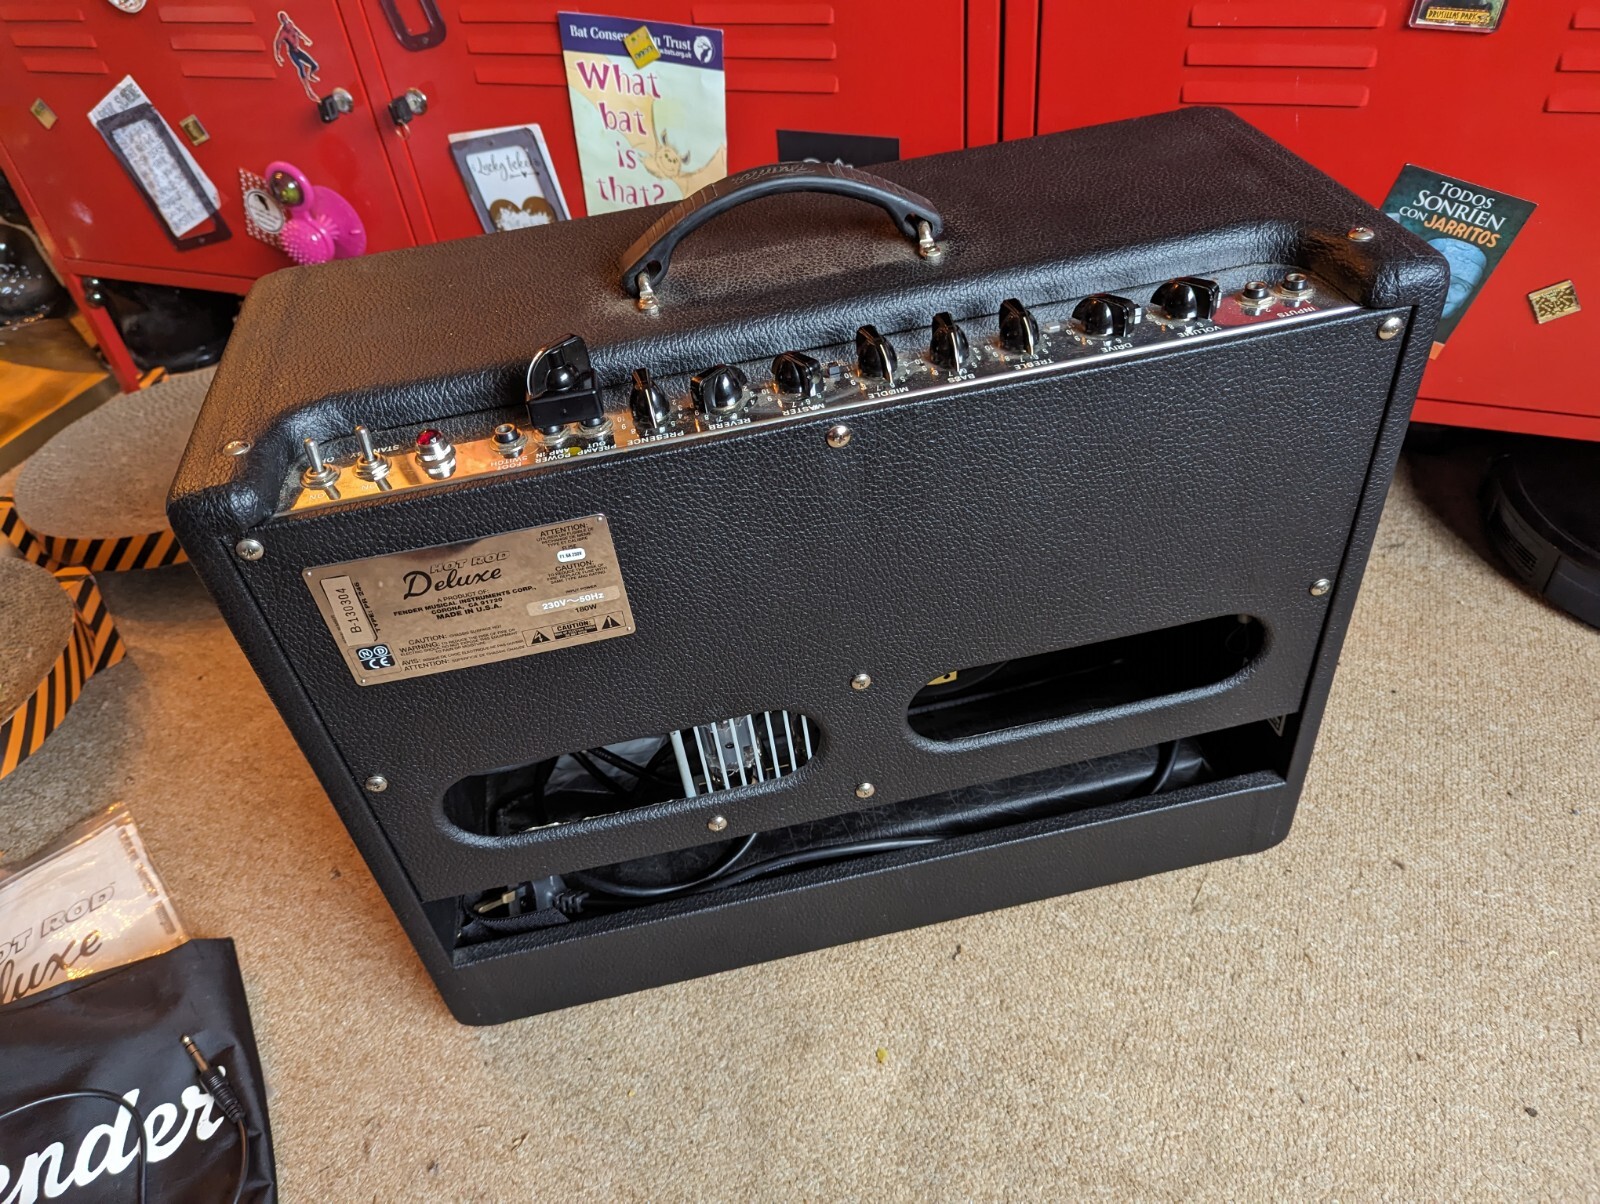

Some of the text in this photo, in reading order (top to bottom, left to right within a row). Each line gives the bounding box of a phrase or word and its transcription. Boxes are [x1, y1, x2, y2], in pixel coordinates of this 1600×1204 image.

[1460, 12, 1478, 20] PARK
[569, 24, 691, 51] Bat Consern Trust
[576, 61, 661, 99] What
[598, 102, 647, 135] bat
[616, 141, 637, 170] is
[596, 176, 665, 206] that?
[1440, 181, 1495, 210] TODOS
[1412, 189, 1507, 231] SONRÍEN
[1399, 206, 1502, 248] CON JARRITOS
[1276, 306, 1316, 318] INPUTS
[1177, 325, 1222, 338] VOLUME
[1100, 342, 1133, 353] DRIVE
[1014, 358, 1054, 370] TREBLE
[947, 373, 976, 383] BASS
[867, 386, 909, 399] MIDDLE
[782, 403, 825, 416] MASTER
[708, 417, 751, 430] REVERB
[626, 430, 685, 446] PRESENCE
[350, 444, 400, 459] STANY
[549, 447, 570, 456] AMP
[577, 443, 617, 456] PREAMP
[587, 441, 606, 449] OUT
[490, 455, 528, 467] SWITCH
[535, 453, 571, 464] POWER
[497, 462, 522, 471] FOOT
[539, 522, 588, 536] ATTENTION:
[430, 551, 510, 574] HOT ROD
[555, 560, 594, 572] CAUTION:
[403, 568, 502, 600] Deluxe
[361, 597, 370, 609] PR
[393, 607, 423, 616] FENDER
[424, 601, 456, 610] MUSICAL
[459, 590, 510, 604] INSTRUMENTS
[443, 592, 476, 601] PRODUCT
[480, 597, 502, 605] 91720
[336, 587, 362, 634] B-130304
[436, 611, 462, 620] MADE
[476, 603, 501, 612] U.S.A.
[575, 604, 597, 613] 180W
[557, 620, 591, 631] CAUTION:
[408, 633, 447, 645] CAUTION:
[399, 641, 440, 653] WARNING:
[401, 658, 421, 666] AVIS:
[404, 659, 449, 671] ATTENTION:
[0, 928, 33, 964] OT
[40, 886, 115, 939] ROD
[0, 929, 103, 1004] luxe
[0, 1088, 225, 1204] nder
